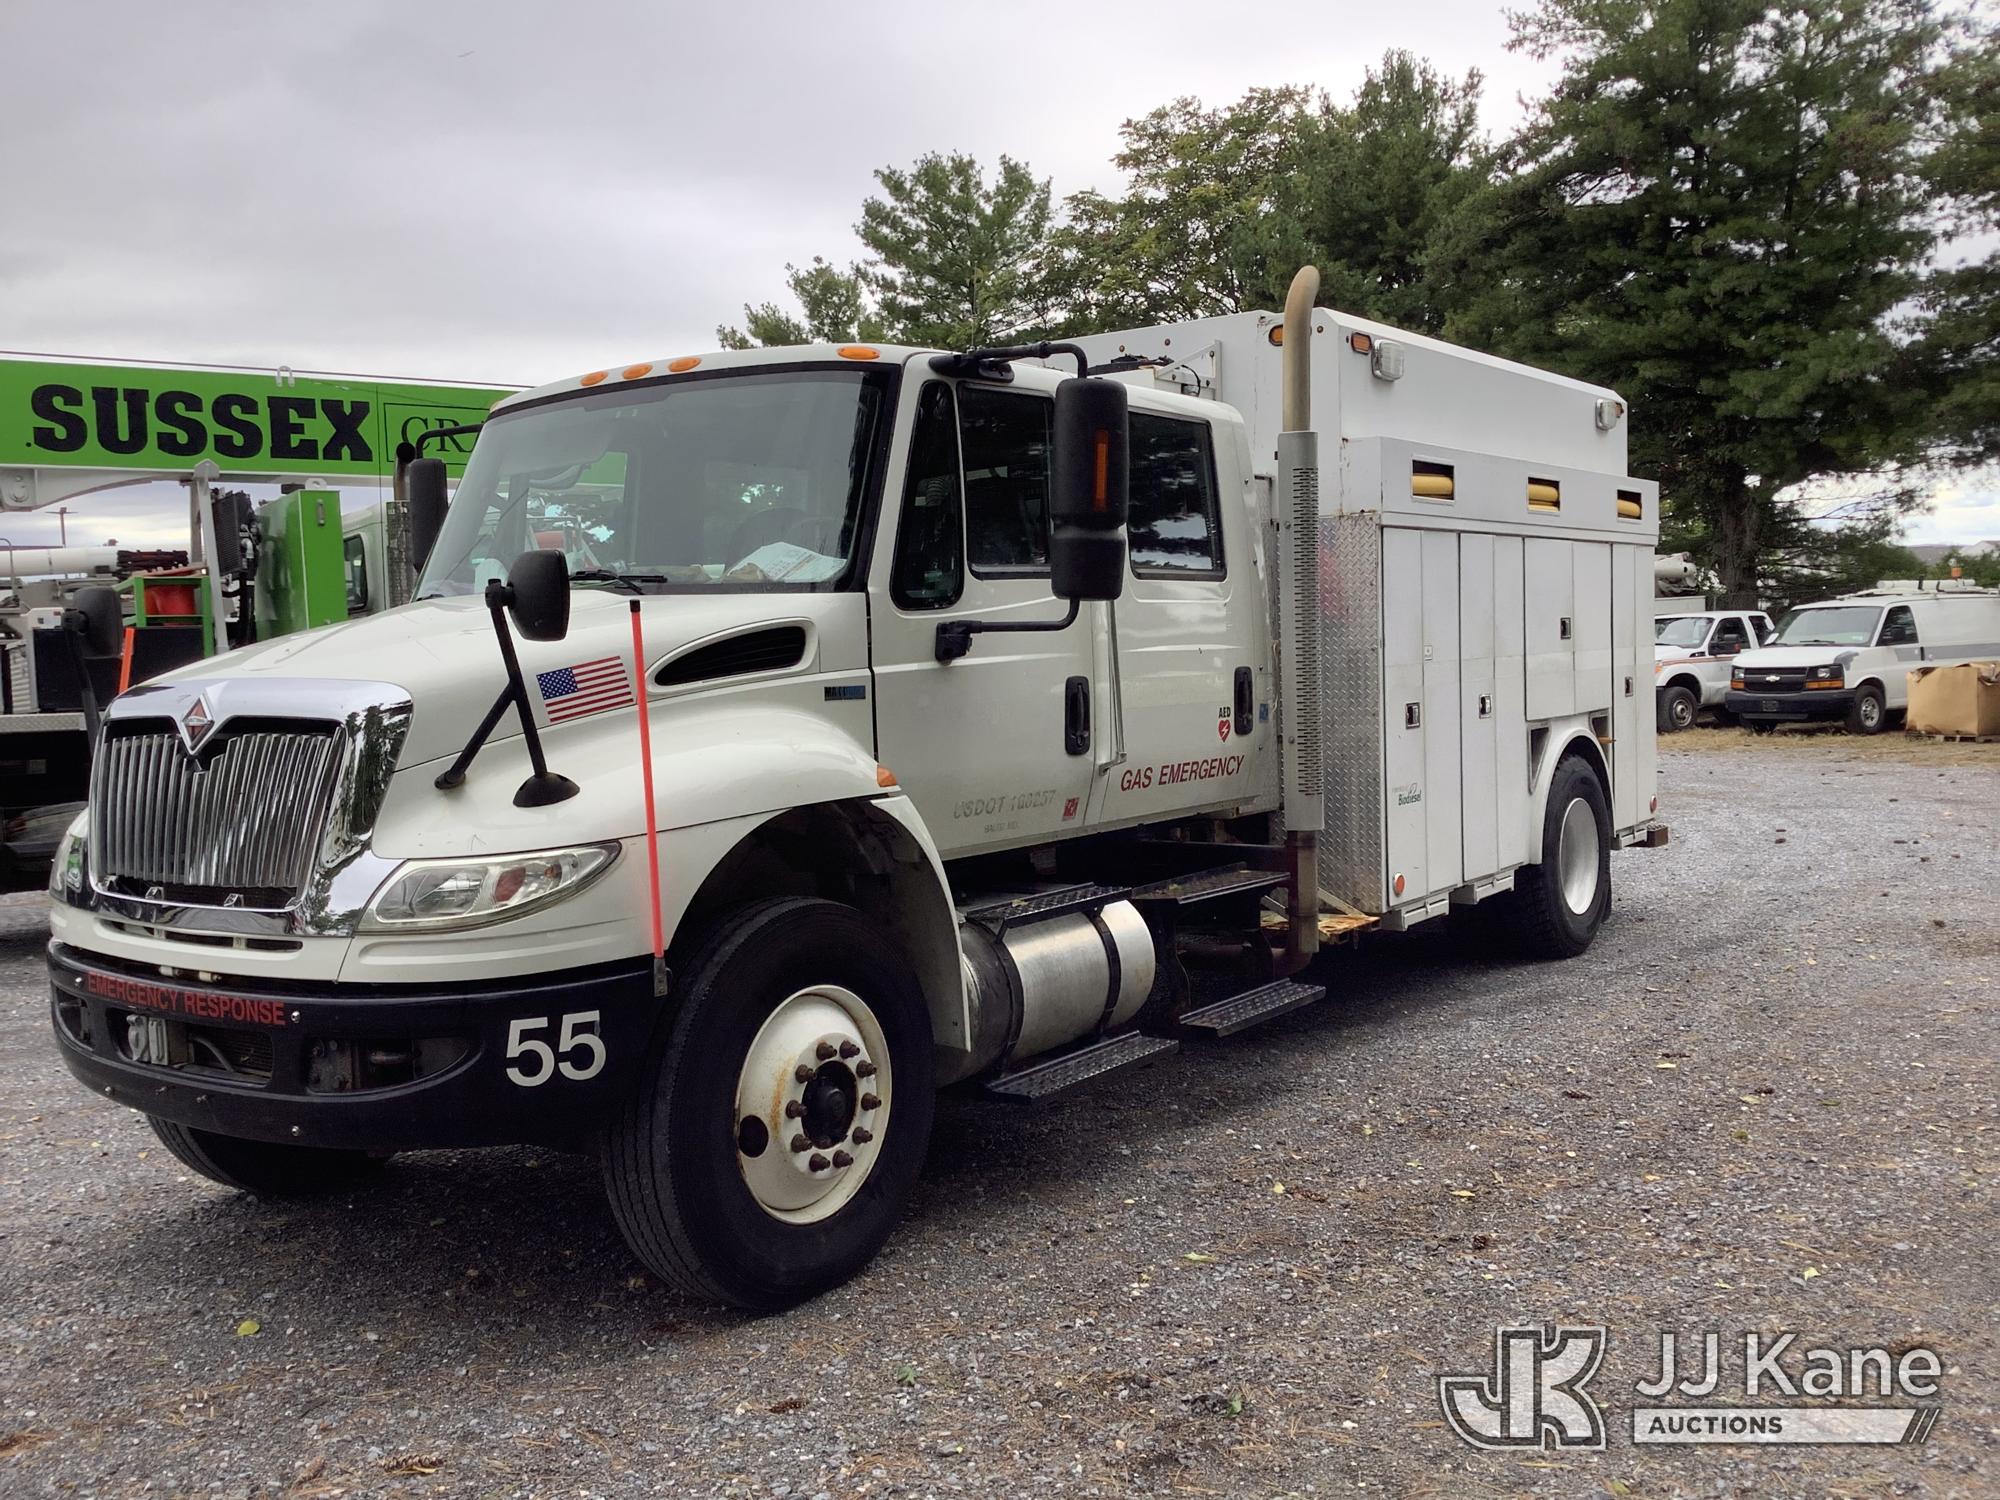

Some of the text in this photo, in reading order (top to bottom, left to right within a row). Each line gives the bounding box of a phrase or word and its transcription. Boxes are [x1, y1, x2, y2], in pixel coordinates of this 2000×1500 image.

[31, 384, 373, 462] SUSSEX
[1218, 706, 1231, 718] AED
[1121, 755, 1245, 791] GAS EMERGENCY
[953, 796, 1006, 819] USDOT
[87, 971, 286, 1025] EMERGENCY RESPONSE
[506, 1010, 606, 1087] 55
